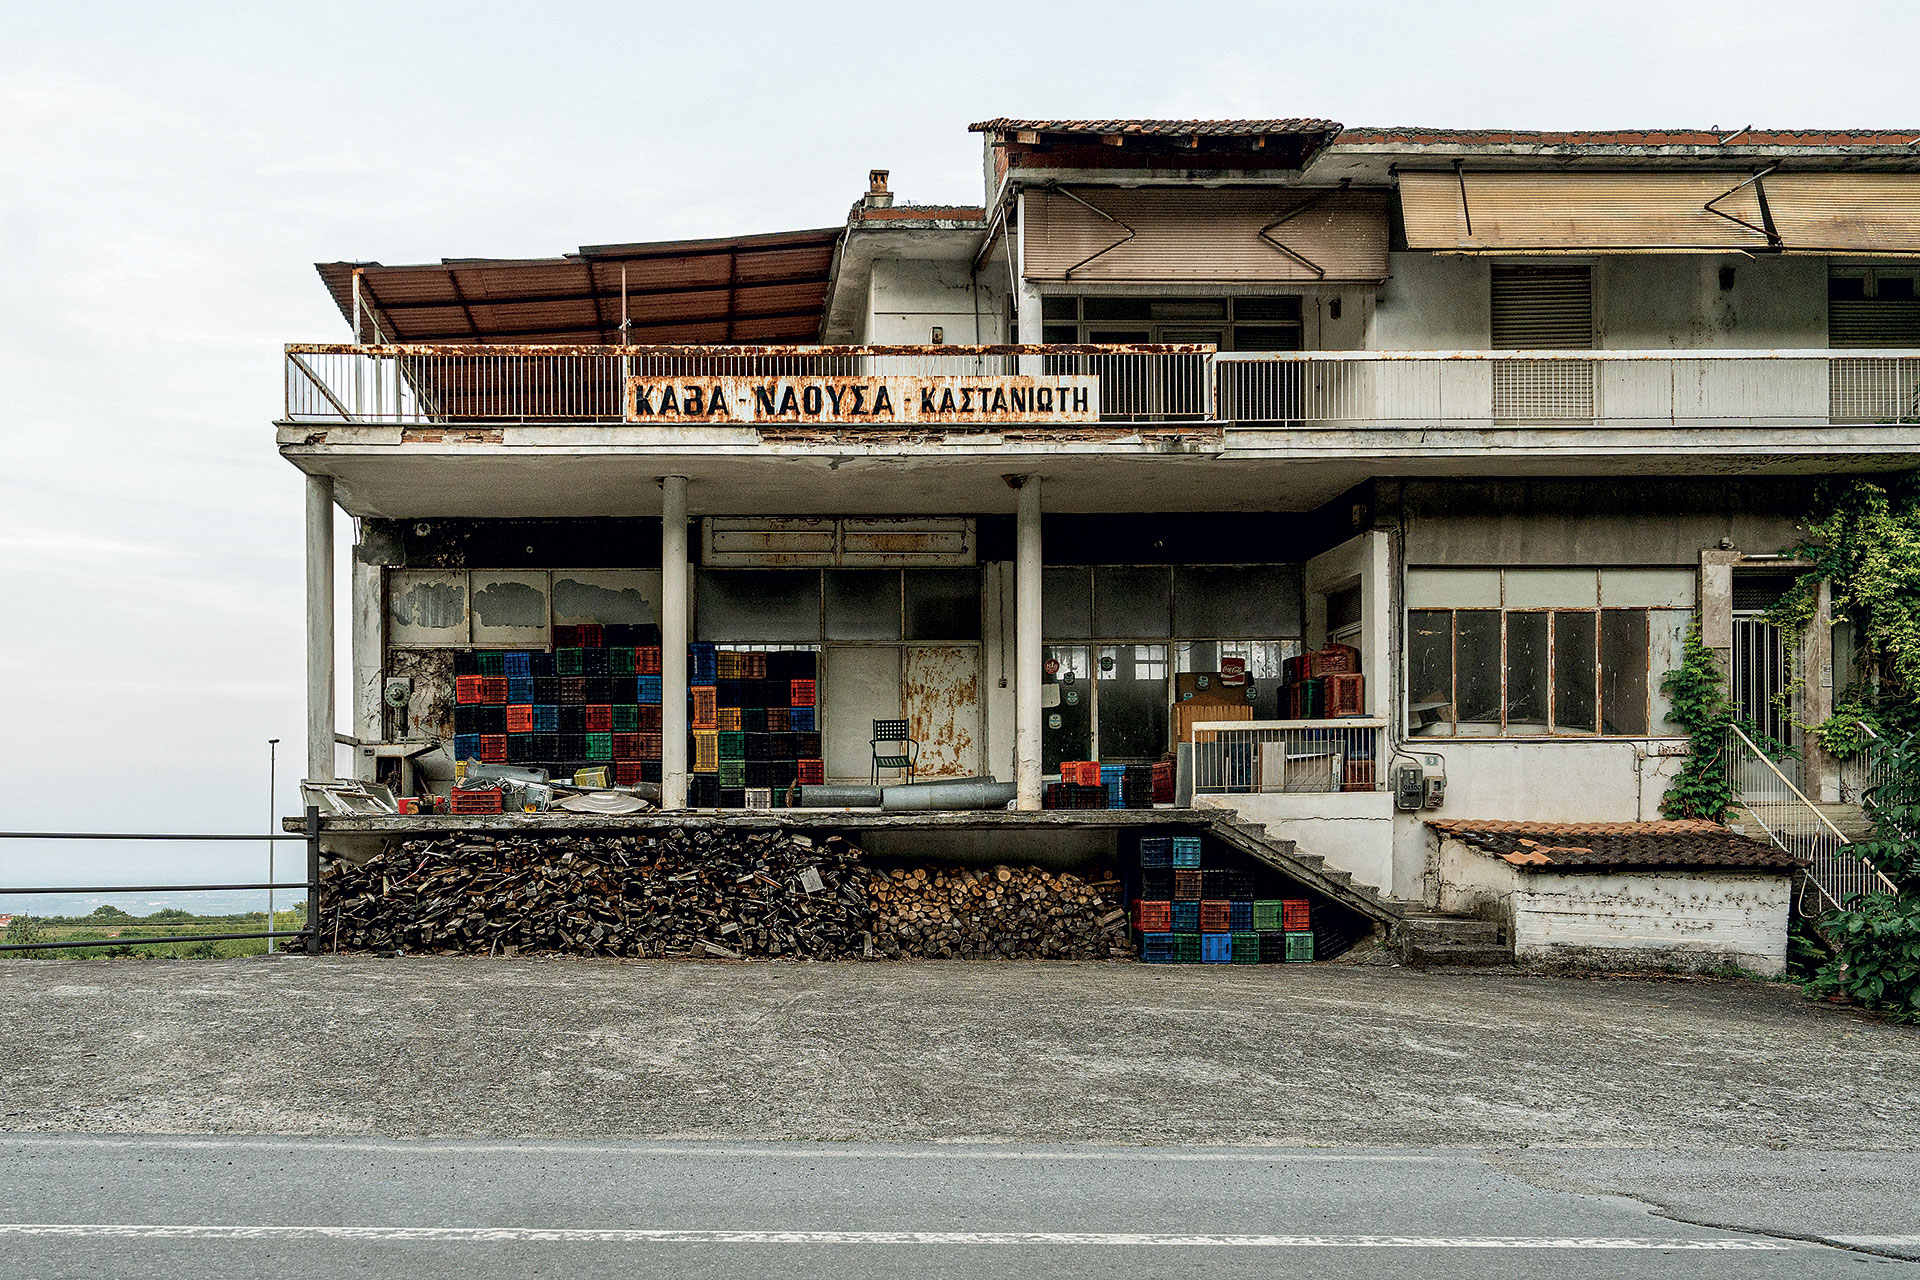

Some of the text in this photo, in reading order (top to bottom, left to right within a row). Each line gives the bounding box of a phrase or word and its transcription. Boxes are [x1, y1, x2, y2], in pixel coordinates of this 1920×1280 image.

[635, 385, 729, 416] ΚΑΒΑ
[756, 385, 894, 416] ΝΑΟΥΣΑ
[921, 387, 1088, 413] ΚΑΣΤΑΝΙΩΤΗ
[1429, 757, 1434, 765] 9
